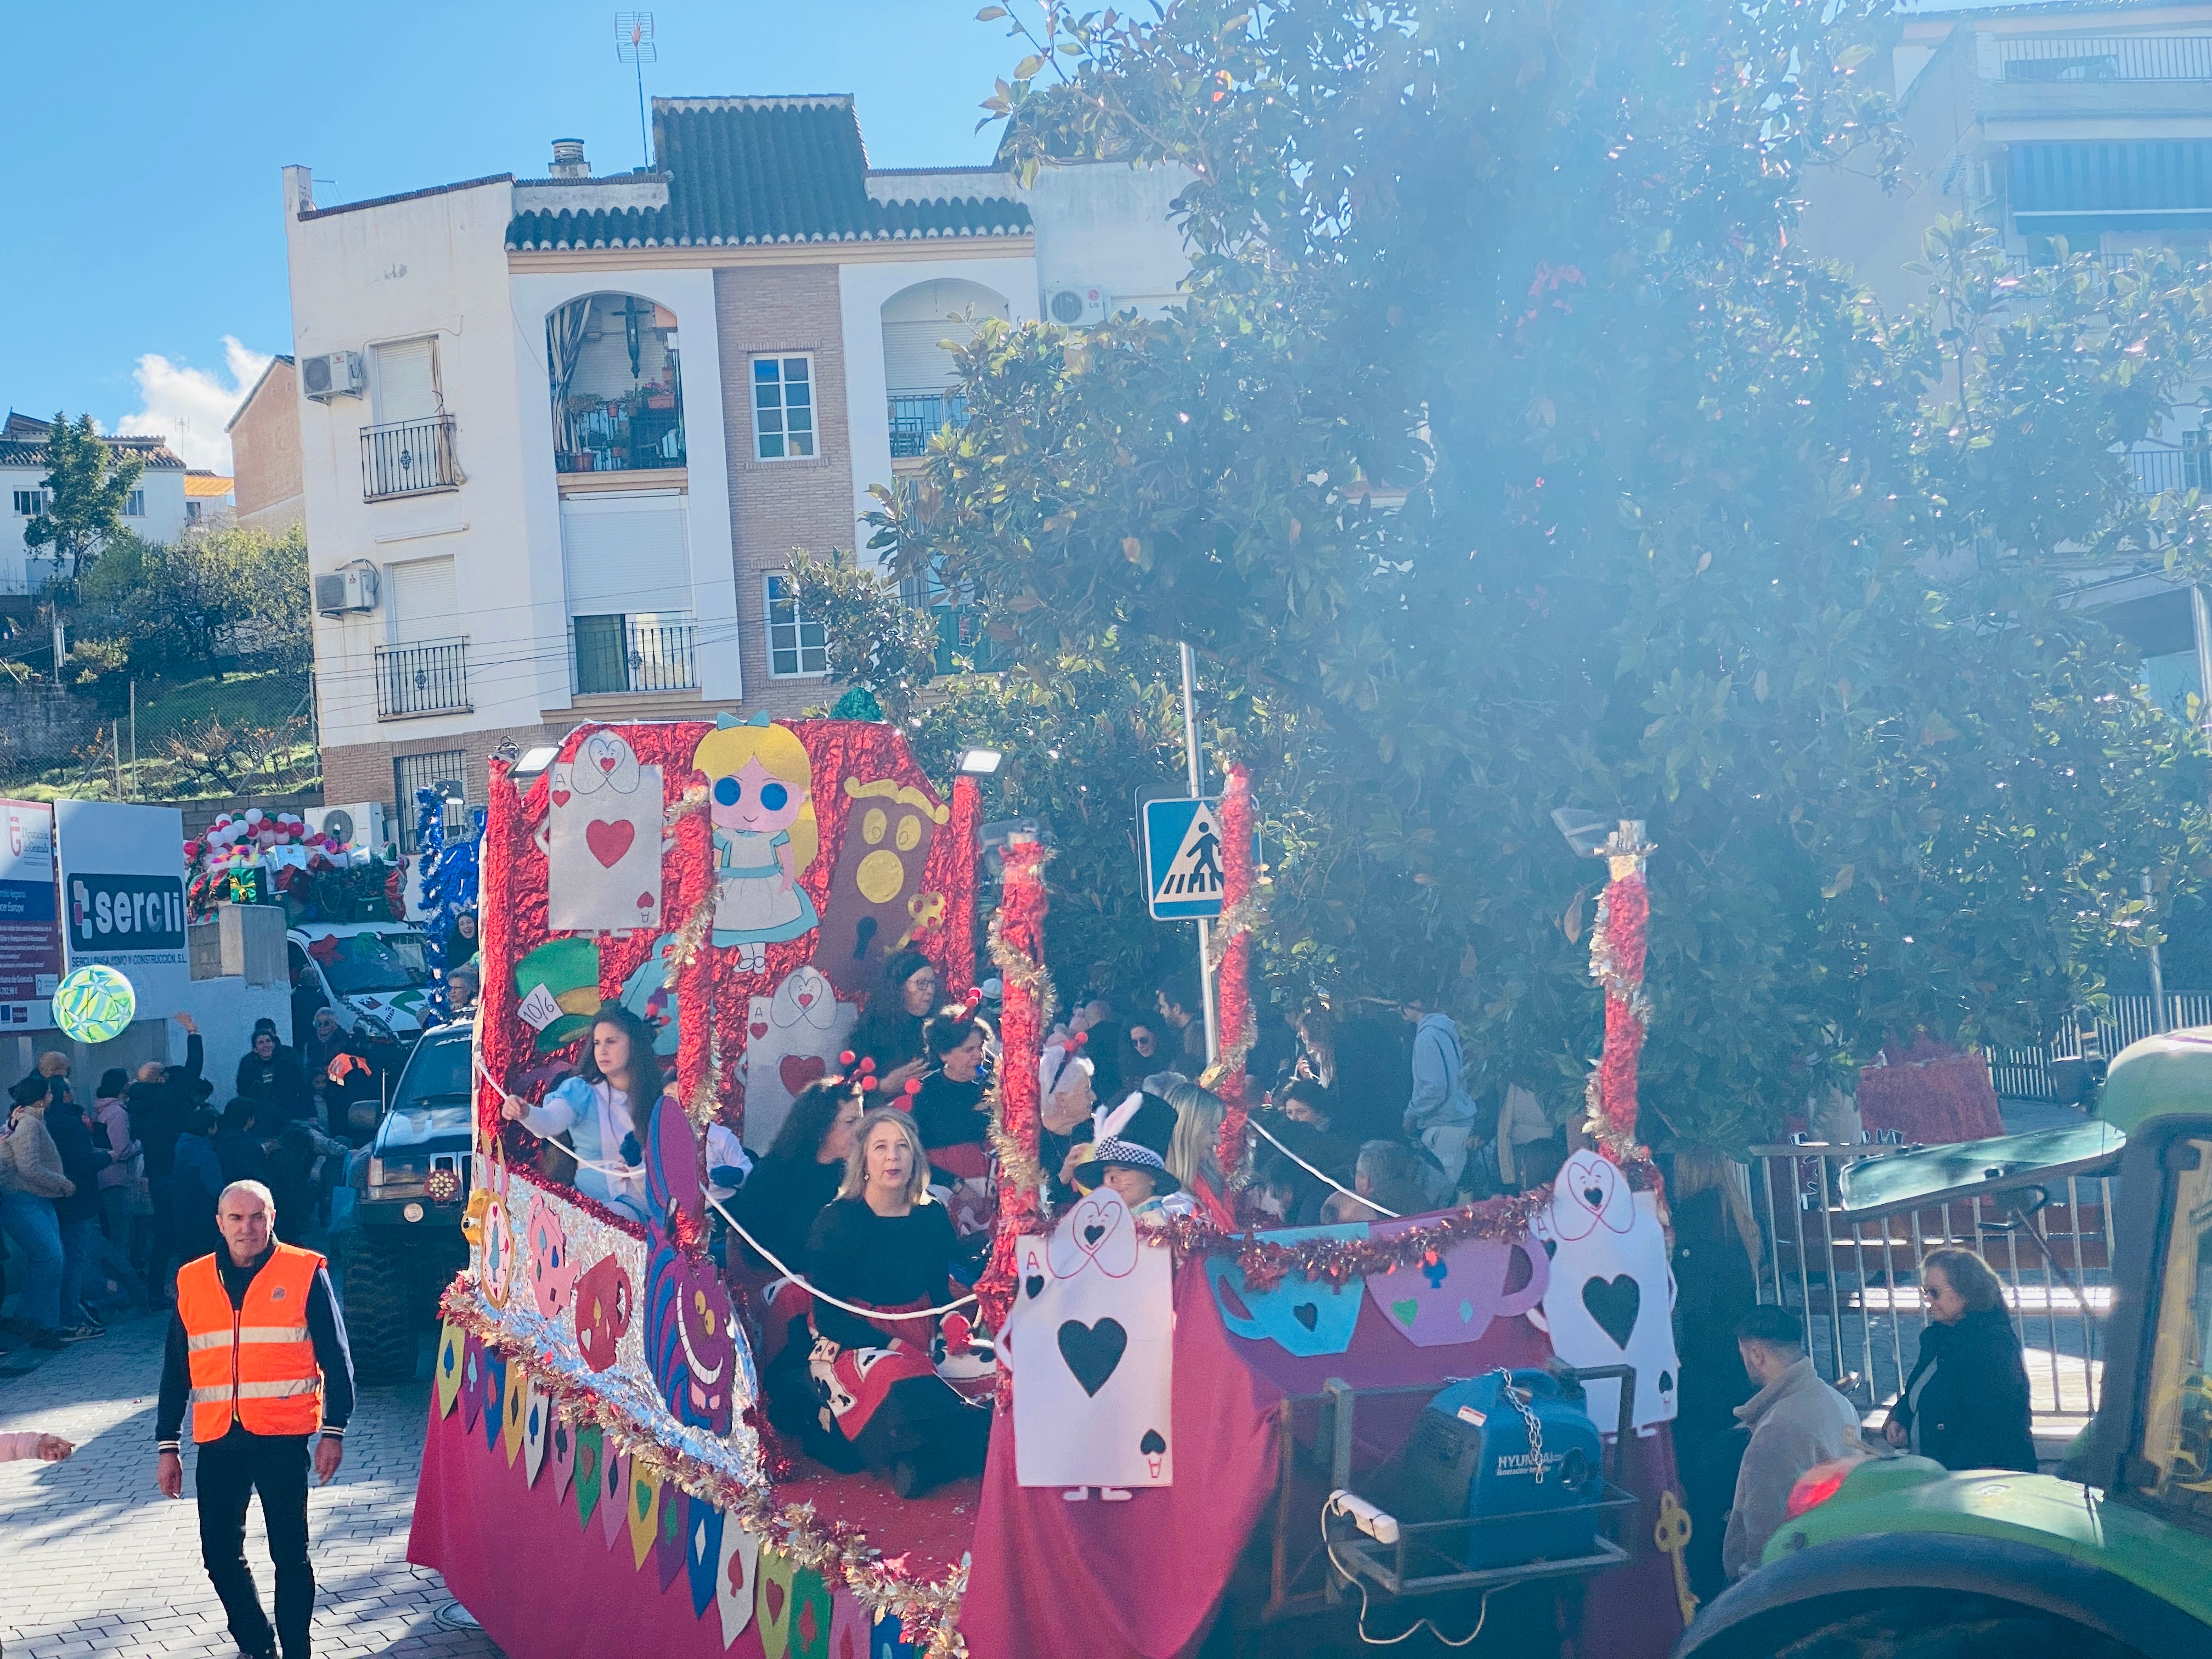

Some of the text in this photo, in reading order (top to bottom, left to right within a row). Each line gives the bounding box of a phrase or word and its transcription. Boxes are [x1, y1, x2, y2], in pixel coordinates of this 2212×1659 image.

[555, 774, 566, 787] A
[95, 891, 181, 934] sercli
[523, 994, 554, 1023] 10/6
[755, 1007, 763, 1019] A
[1026, 1251, 1040, 1270] A
